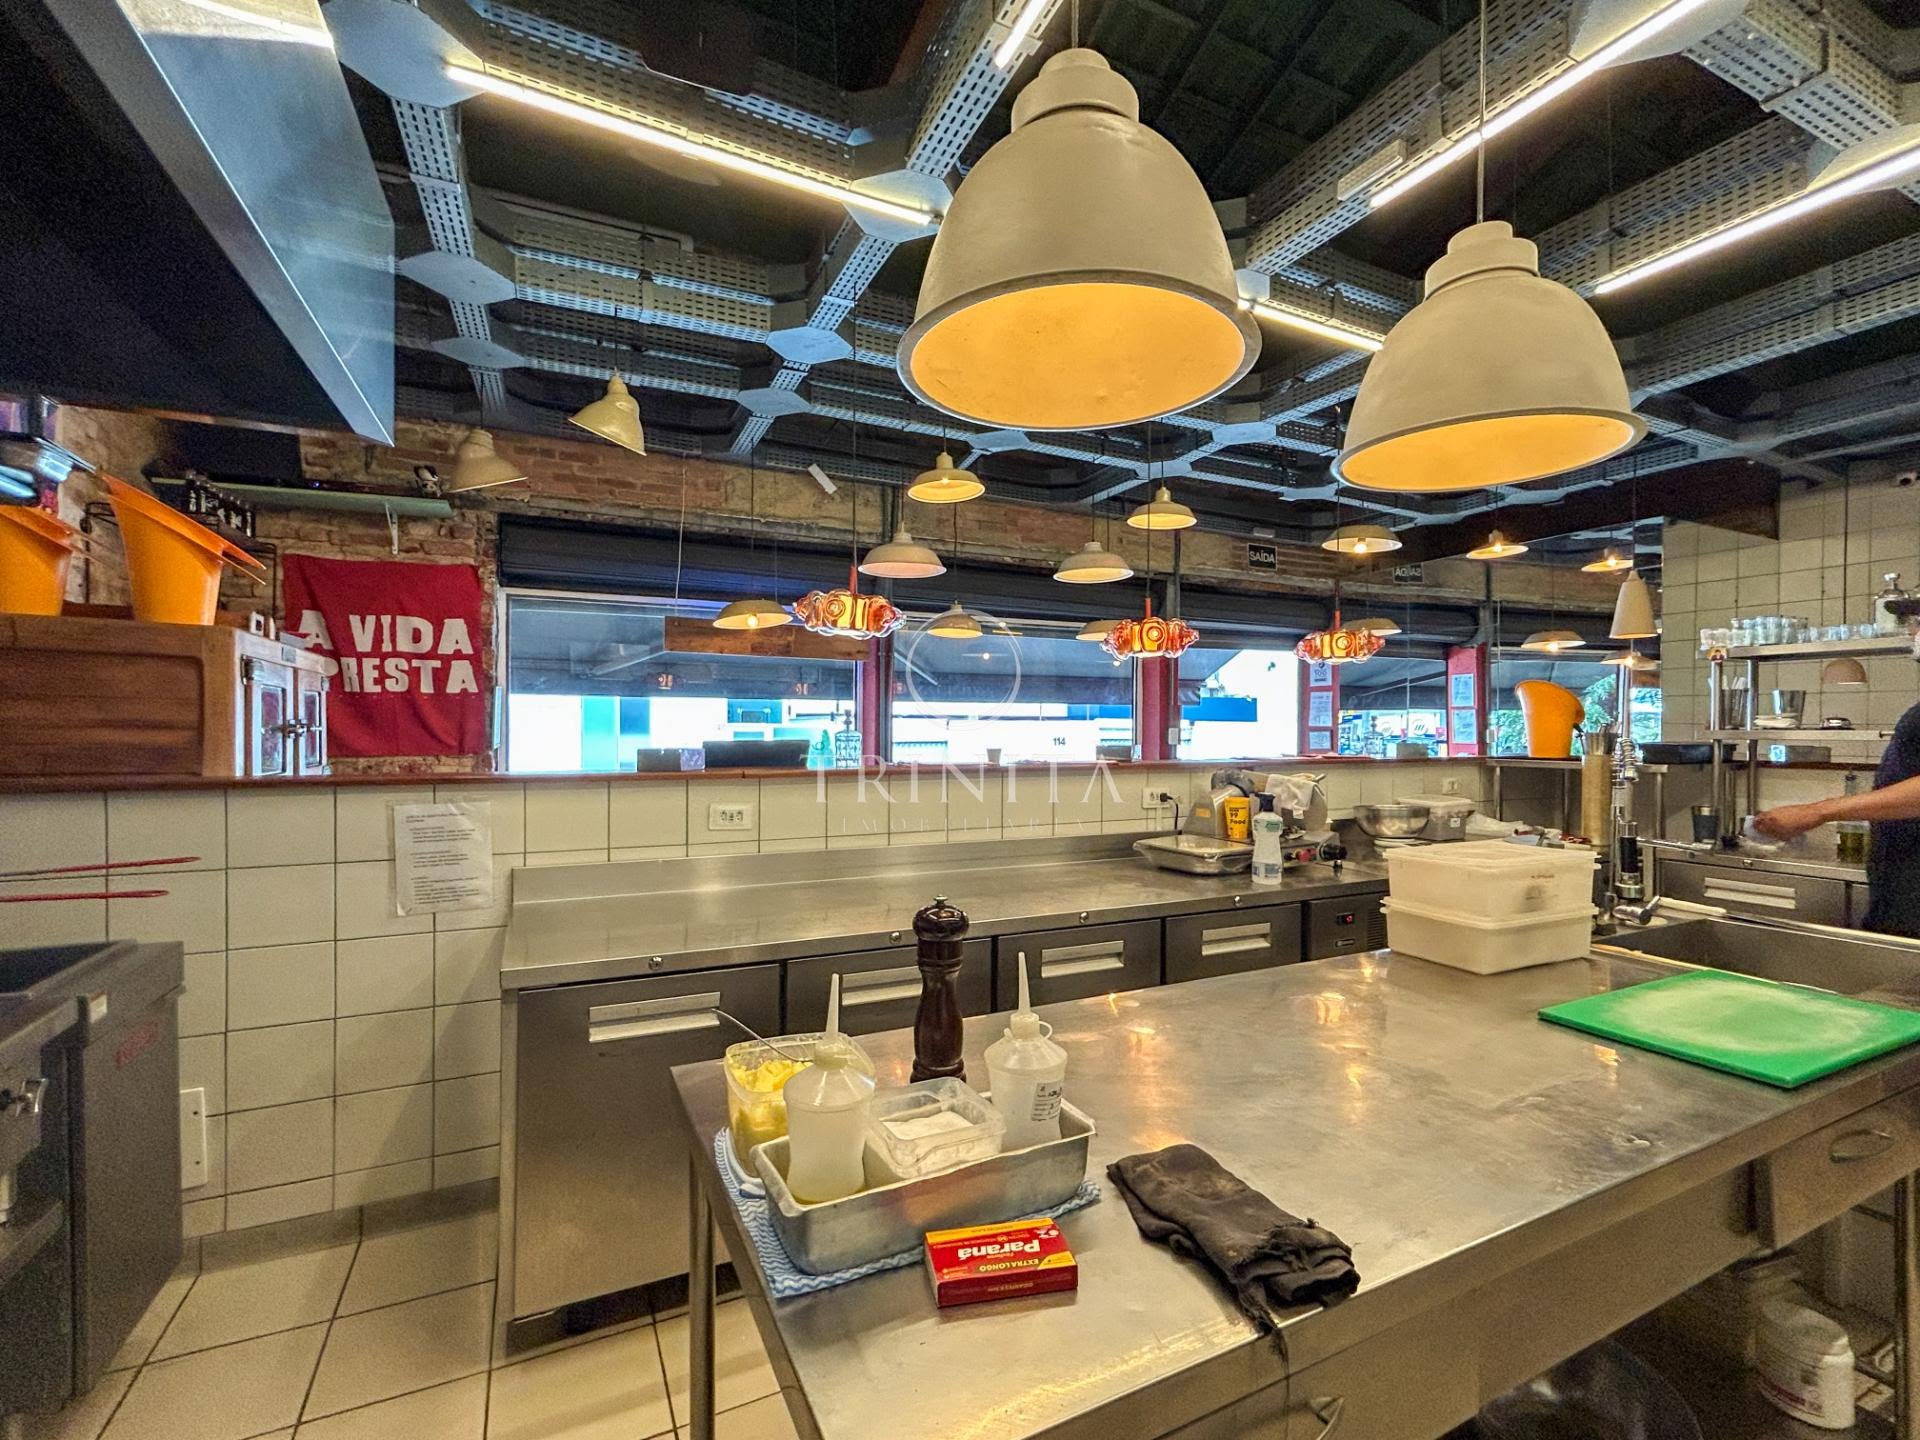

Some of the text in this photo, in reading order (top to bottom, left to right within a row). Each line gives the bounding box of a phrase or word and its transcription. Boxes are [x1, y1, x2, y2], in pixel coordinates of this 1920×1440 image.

[1249, 549, 1276, 564] SAÍDA
[299, 609, 474, 655] A VIDA
[1052, 736, 1066, 746] 114
[957, 1239, 1041, 1260] Paraná
[979, 1261, 1010, 1272] LONGO
[1010, 1258, 1040, 1268] EXTRA
